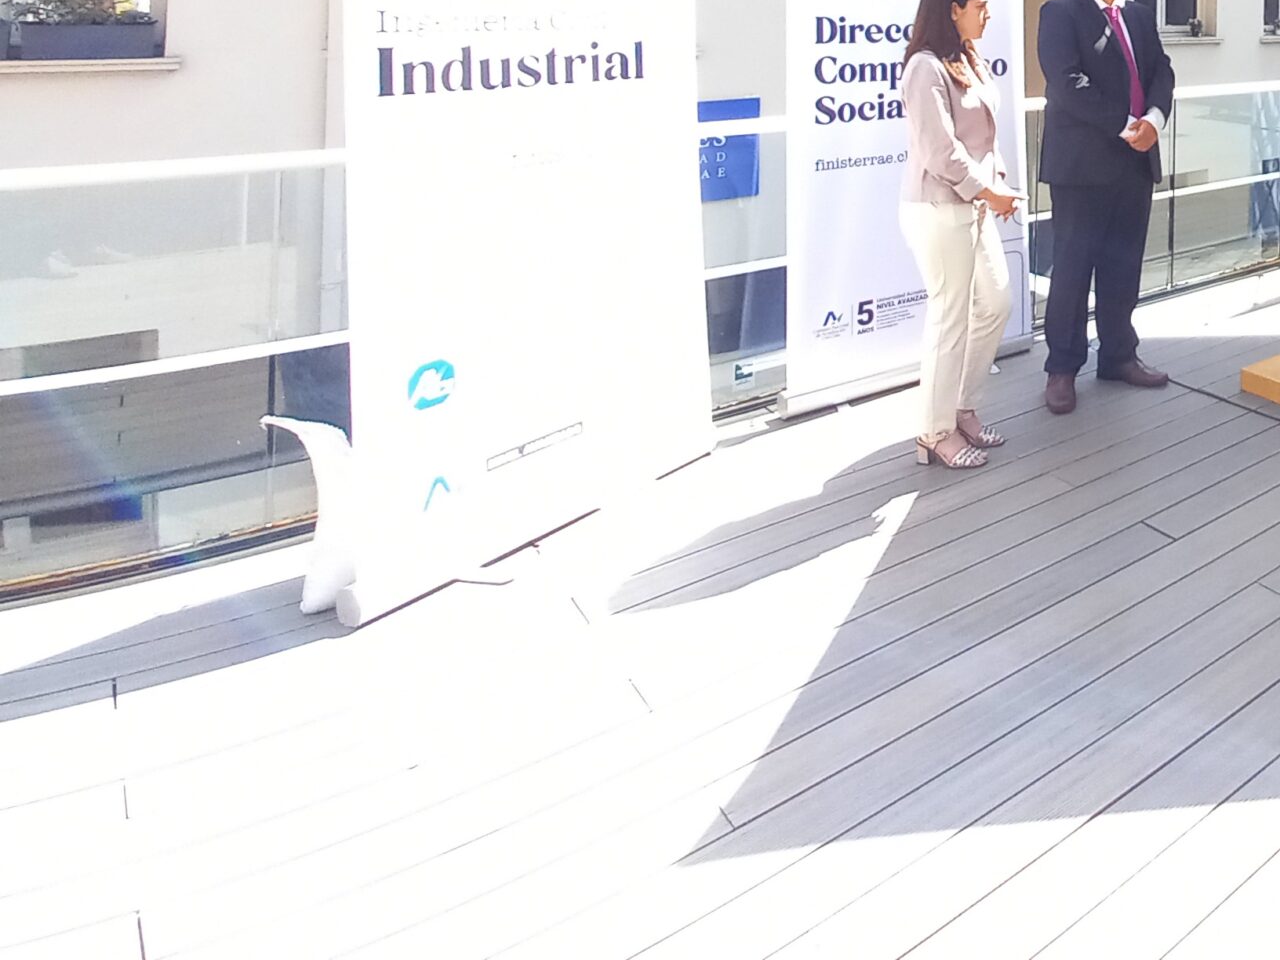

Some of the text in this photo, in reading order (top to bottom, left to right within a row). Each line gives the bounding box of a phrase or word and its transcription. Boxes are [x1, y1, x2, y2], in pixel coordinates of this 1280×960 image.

[376, 40, 645, 98] Industrial
[814, 92, 908, 126] Socia
[857, 298, 874, 326] 5
[876, 300, 896, 310] NIVEL
[896, 293, 929, 307] AVANZAD
